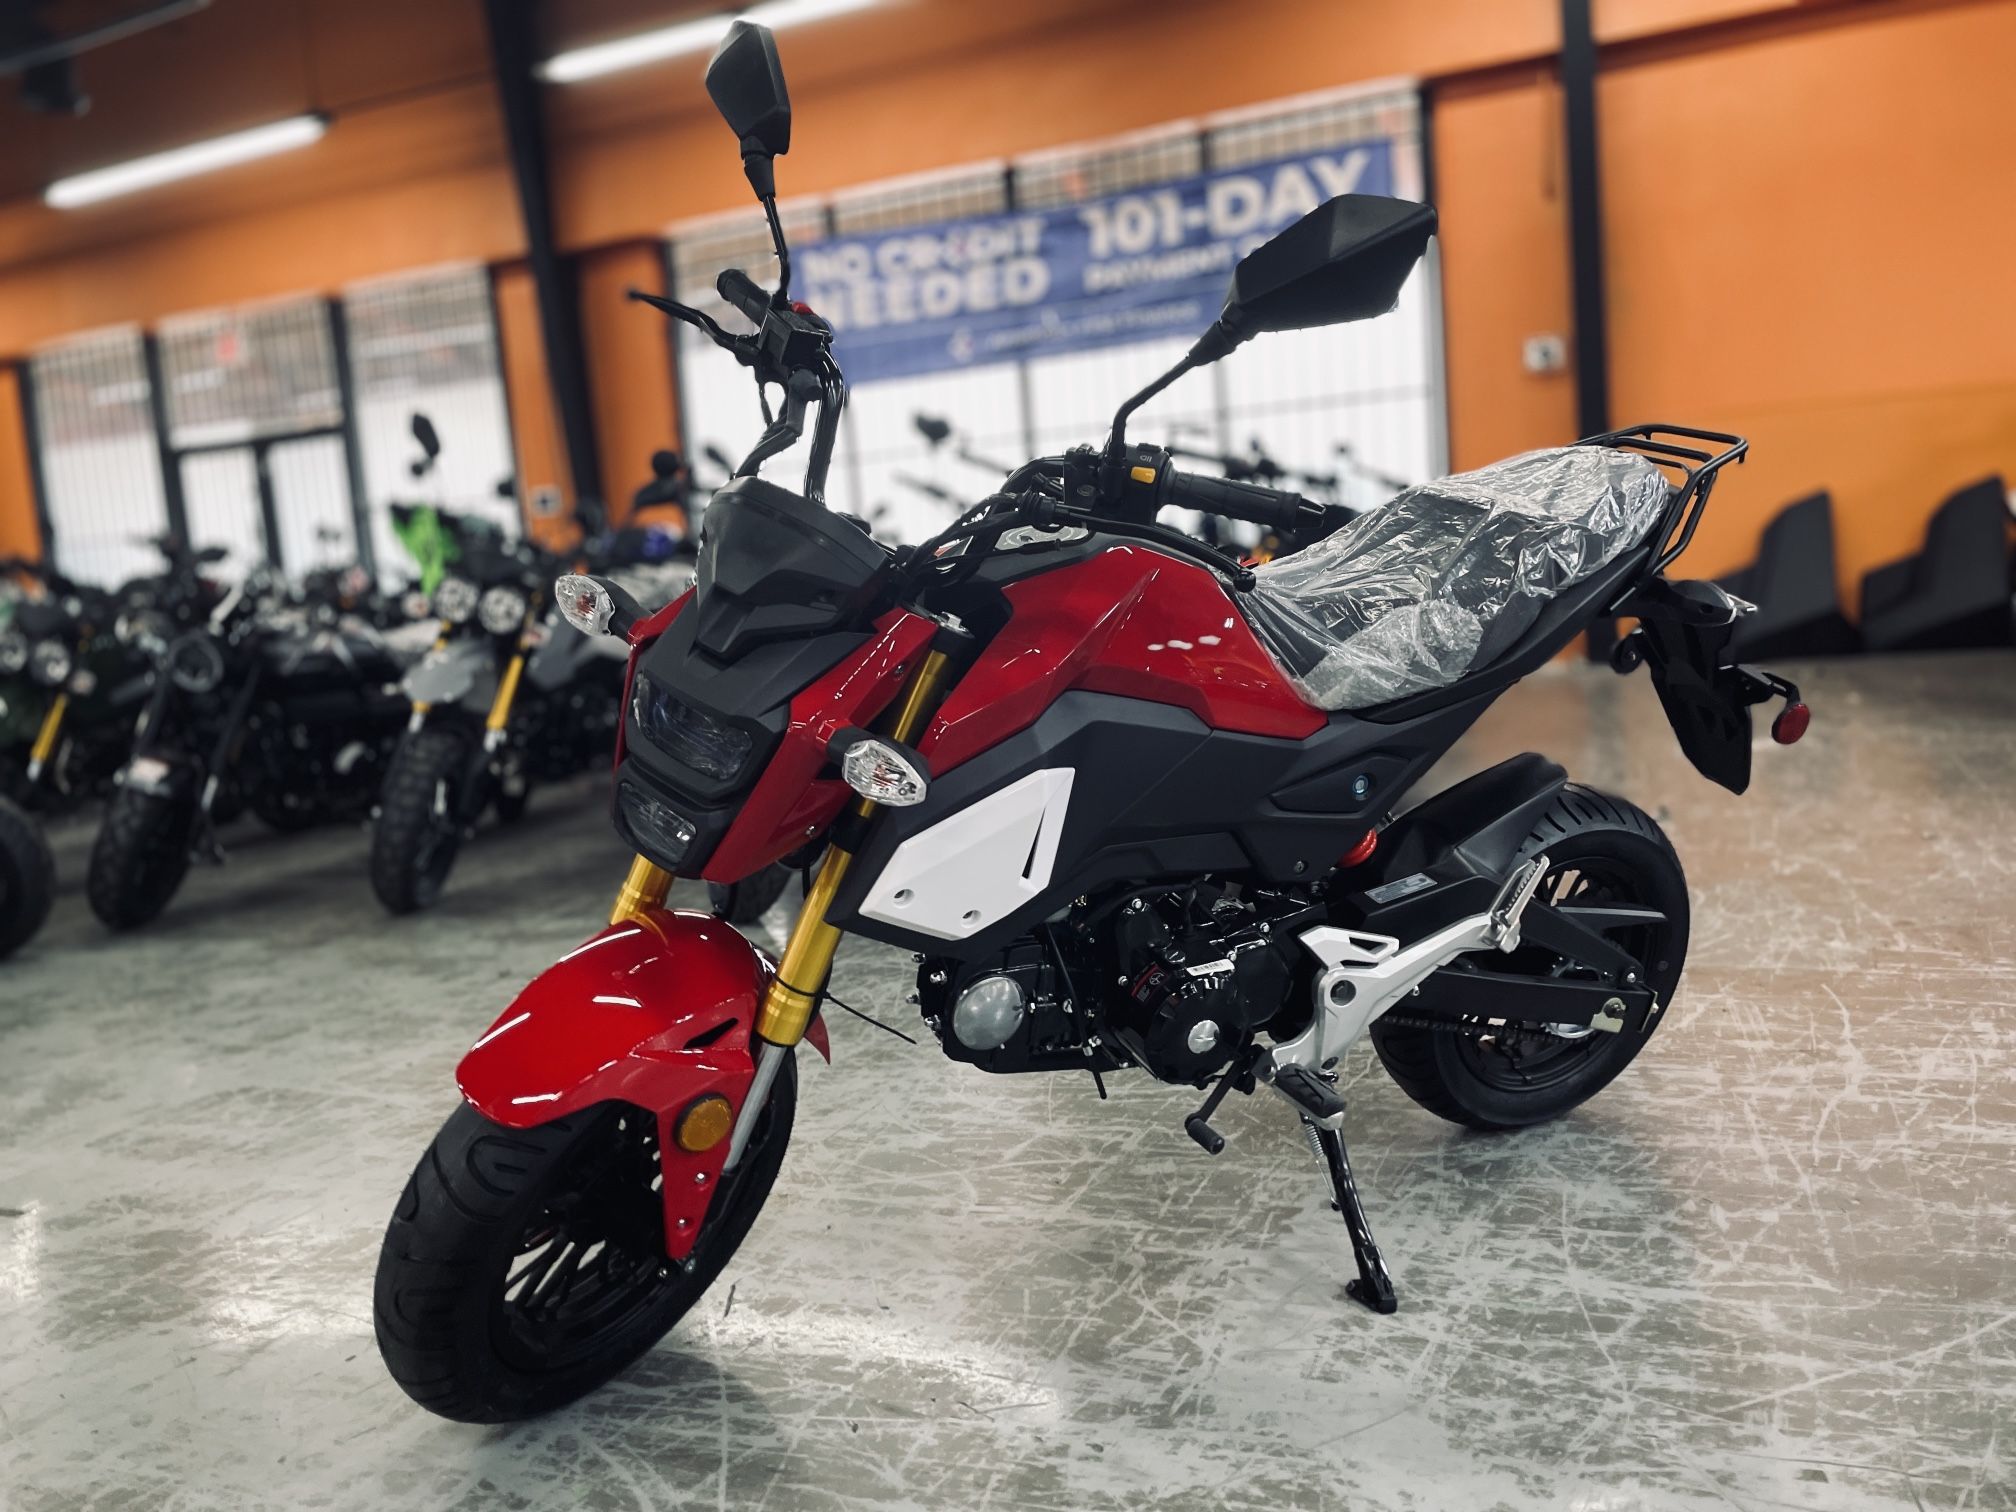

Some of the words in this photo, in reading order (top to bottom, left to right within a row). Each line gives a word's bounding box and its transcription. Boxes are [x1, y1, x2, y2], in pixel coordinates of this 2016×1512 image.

[1080, 149, 1371, 257] 101-DAY
[801, 241, 871, 282] NO
[806, 256, 1051, 332] NEEDED
